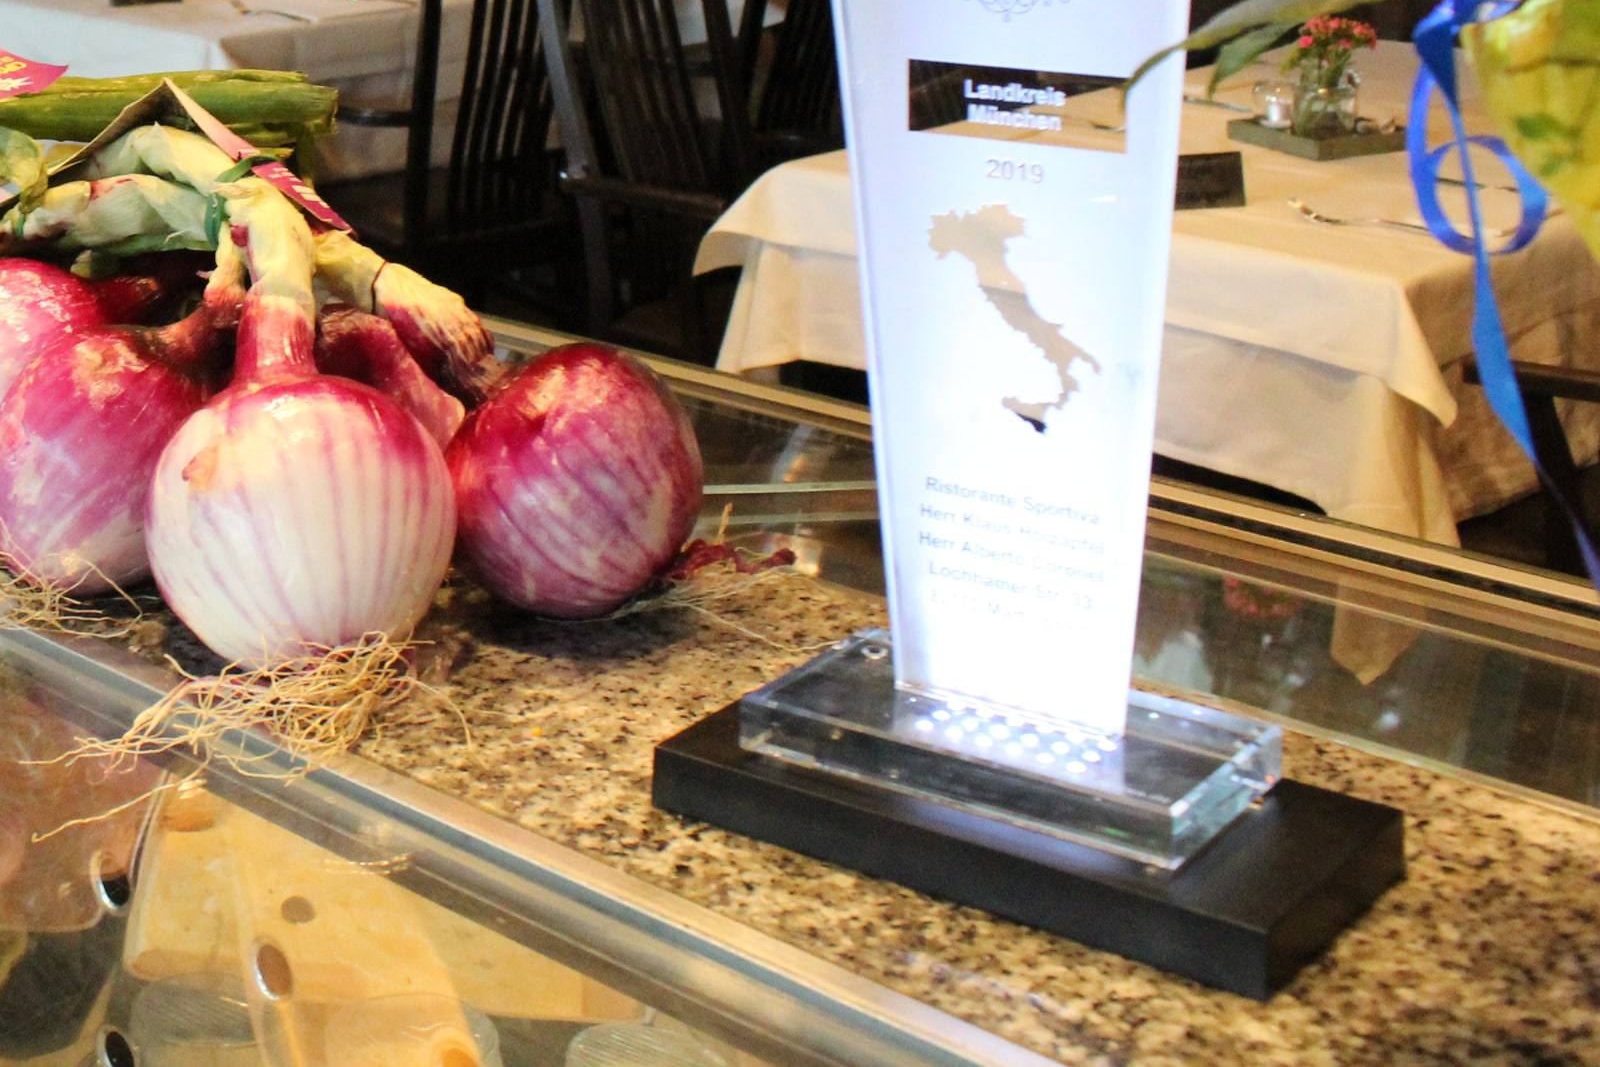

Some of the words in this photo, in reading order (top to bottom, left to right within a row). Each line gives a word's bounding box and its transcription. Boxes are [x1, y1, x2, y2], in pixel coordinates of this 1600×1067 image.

[963, 78, 1067, 107] Landkreis
[966, 102, 1062, 132] München
[986, 158, 1045, 184] 2019
[925, 476, 1017, 508] Ristorante
[919, 503, 956, 522] Herr
[918, 530, 956, 549] Herr
